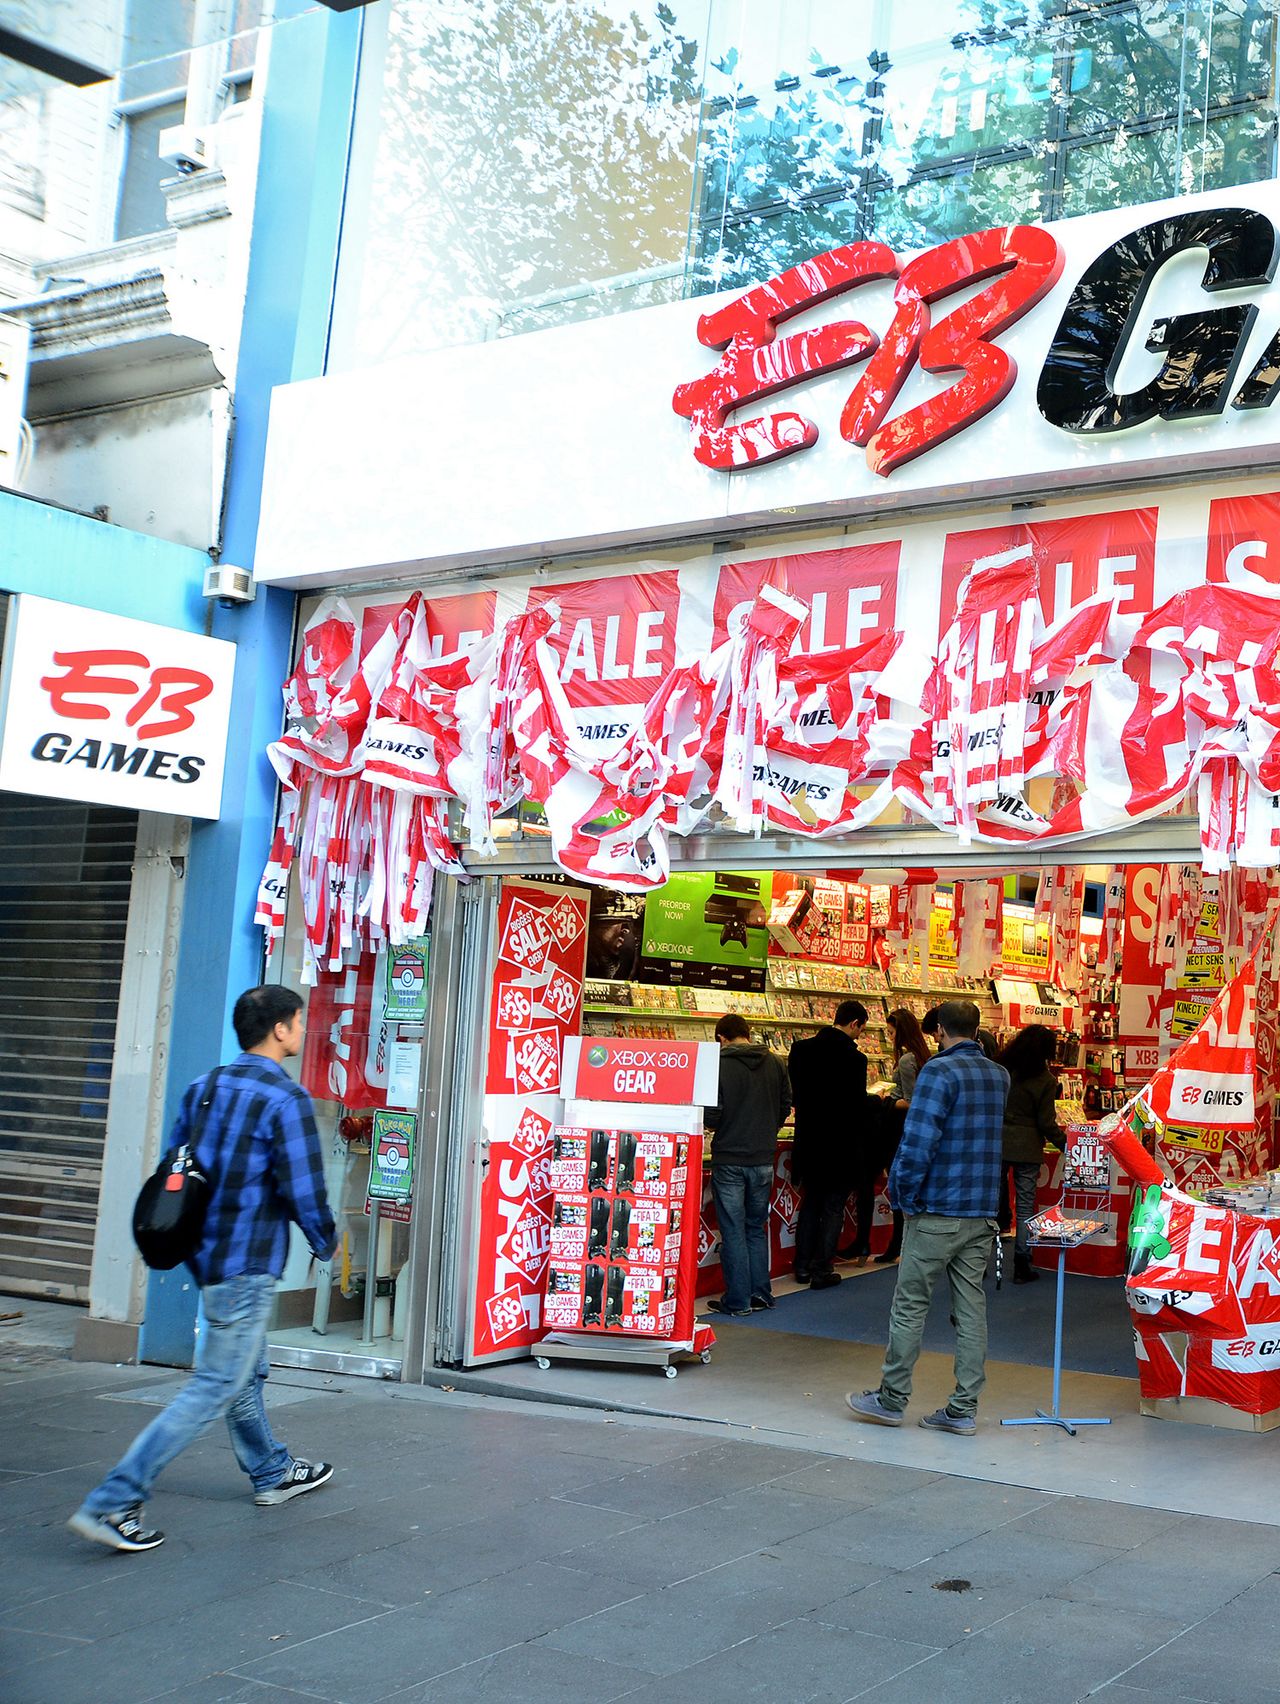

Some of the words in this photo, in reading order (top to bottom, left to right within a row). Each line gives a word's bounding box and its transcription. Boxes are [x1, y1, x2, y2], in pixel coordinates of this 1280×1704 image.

[672, 225, 1065, 478] EB
[40, 649, 214, 741] EB
[31, 733, 206, 784] GAMES
[658, 899, 691, 911] PREORDER
[824, 893, 844, 906] GAMES
[511, 911, 535, 930] BIGGEST
[552, 909, 576, 940] $36
[664, 910, 684, 921] NOW!
[509, 916, 550, 963] SALE
[819, 938, 840, 956] $269
[527, 950, 545, 969] EVER!
[547, 981, 574, 1015] $28
[501, 991, 531, 1026] $36
[534, 1034, 557, 1058] BIGGEST
[515, 1040, 556, 1089] SALE
[611, 1050, 655, 1067] XBOX
[658, 1052, 689, 1069] 360
[614, 1071, 656, 1094] GEAR
[1181, 1085, 1202, 1105] EB
[1203, 1090, 1244, 1106] GAMES
[516, 1119, 545, 1152] $36
[1077, 1137, 1099, 1146] BIGGEST
[1200, 1129, 1221, 1150] $48
[639, 1144, 657, 1154] +FIFA
[658, 1144, 666, 1155] 12
[1071, 1146, 1104, 1168] SALE
[561, 1163, 583, 1173] GAMES
[560, 1176, 583, 1190] $269
[1192, 1174, 1215, 1184] BIGGEST
[645, 1183, 666, 1197] $199
[516, 1216, 542, 1233] BIGGEST
[633, 1211, 651, 1221] +FIFA
[653, 1212, 660, 1221] 12
[511, 1225, 551, 1264] SALE
[493, 1299, 521, 1332] $36
[1226, 1340, 1256, 1358] EB
